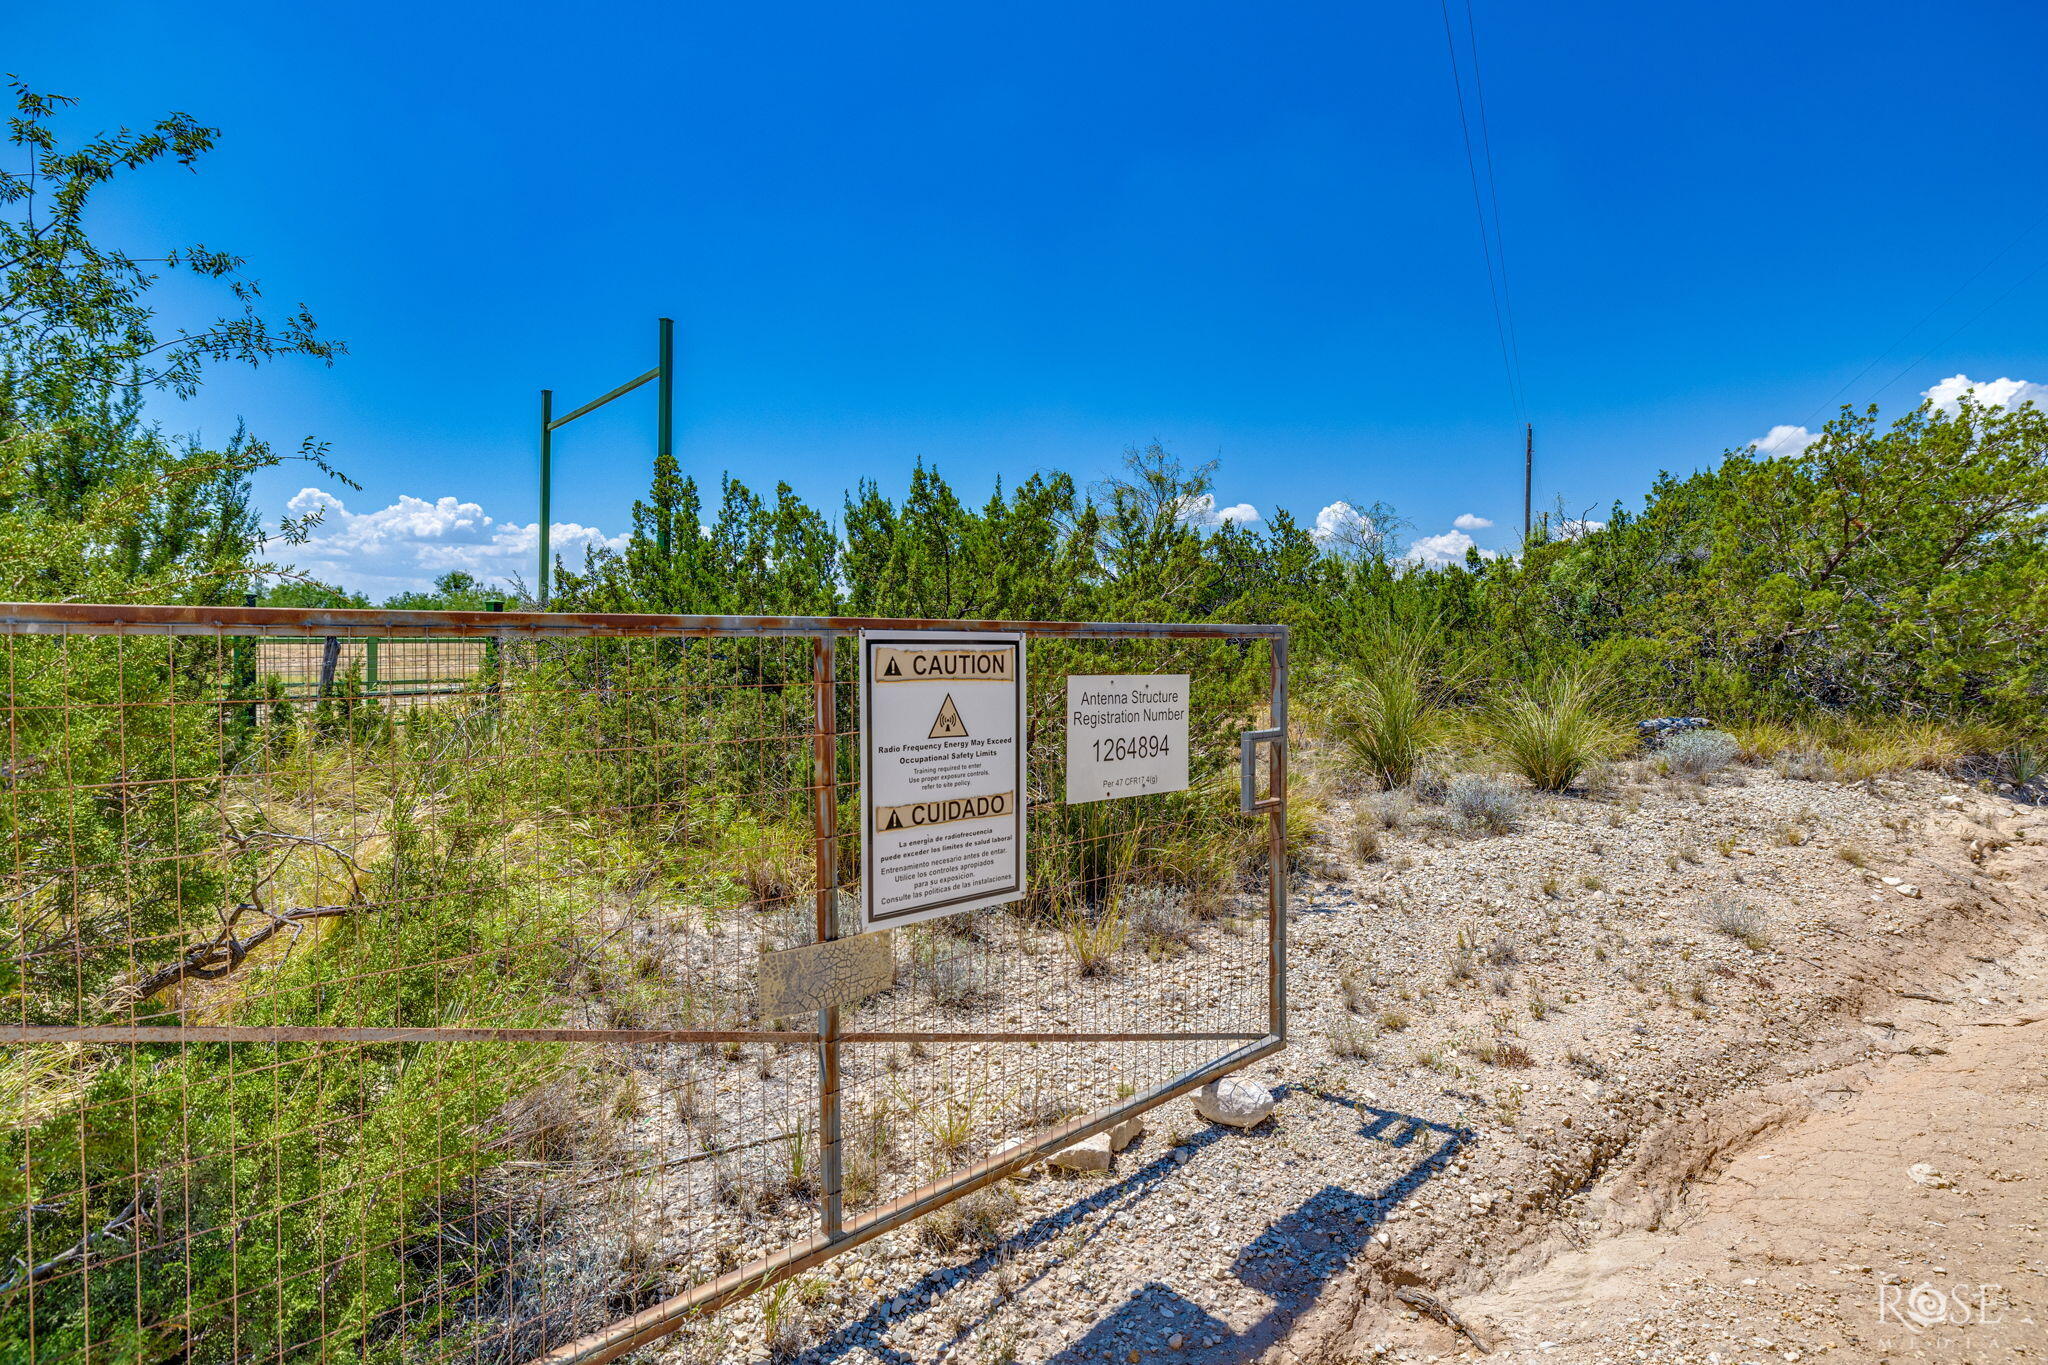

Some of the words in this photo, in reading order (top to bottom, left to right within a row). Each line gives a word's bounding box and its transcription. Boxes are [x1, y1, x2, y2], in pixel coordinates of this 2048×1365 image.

[913, 654, 1005, 675] CAUTION
[1081, 691, 1127, 705] Antenna
[1132, 690, 1178, 704] Structure
[1074, 710, 1139, 728] Registration
[1144, 708, 1184, 721] Number
[903, 743, 941, 752] Frequency
[944, 740, 968, 748] Energy
[1093, 735, 1169, 762] 1264894
[900, 754, 949, 764] Occupational
[914, 766, 936, 774] Training
[938, 764, 961, 772] required
[911, 795, 1005, 825] CUIDADO
[945, 829, 992, 840] radiofrecuencia
[881, 854, 901, 863] puede
[903, 849, 929, 858] exceder
[992, 835, 1012, 843] laboral
[881, 862, 929, 875] Entrenamiento
[931, 856, 961, 866] necesario
[929, 866, 958, 876] controles
[961, 859, 994, 871] apropiados
[881, 894, 910, 905] Consulte
